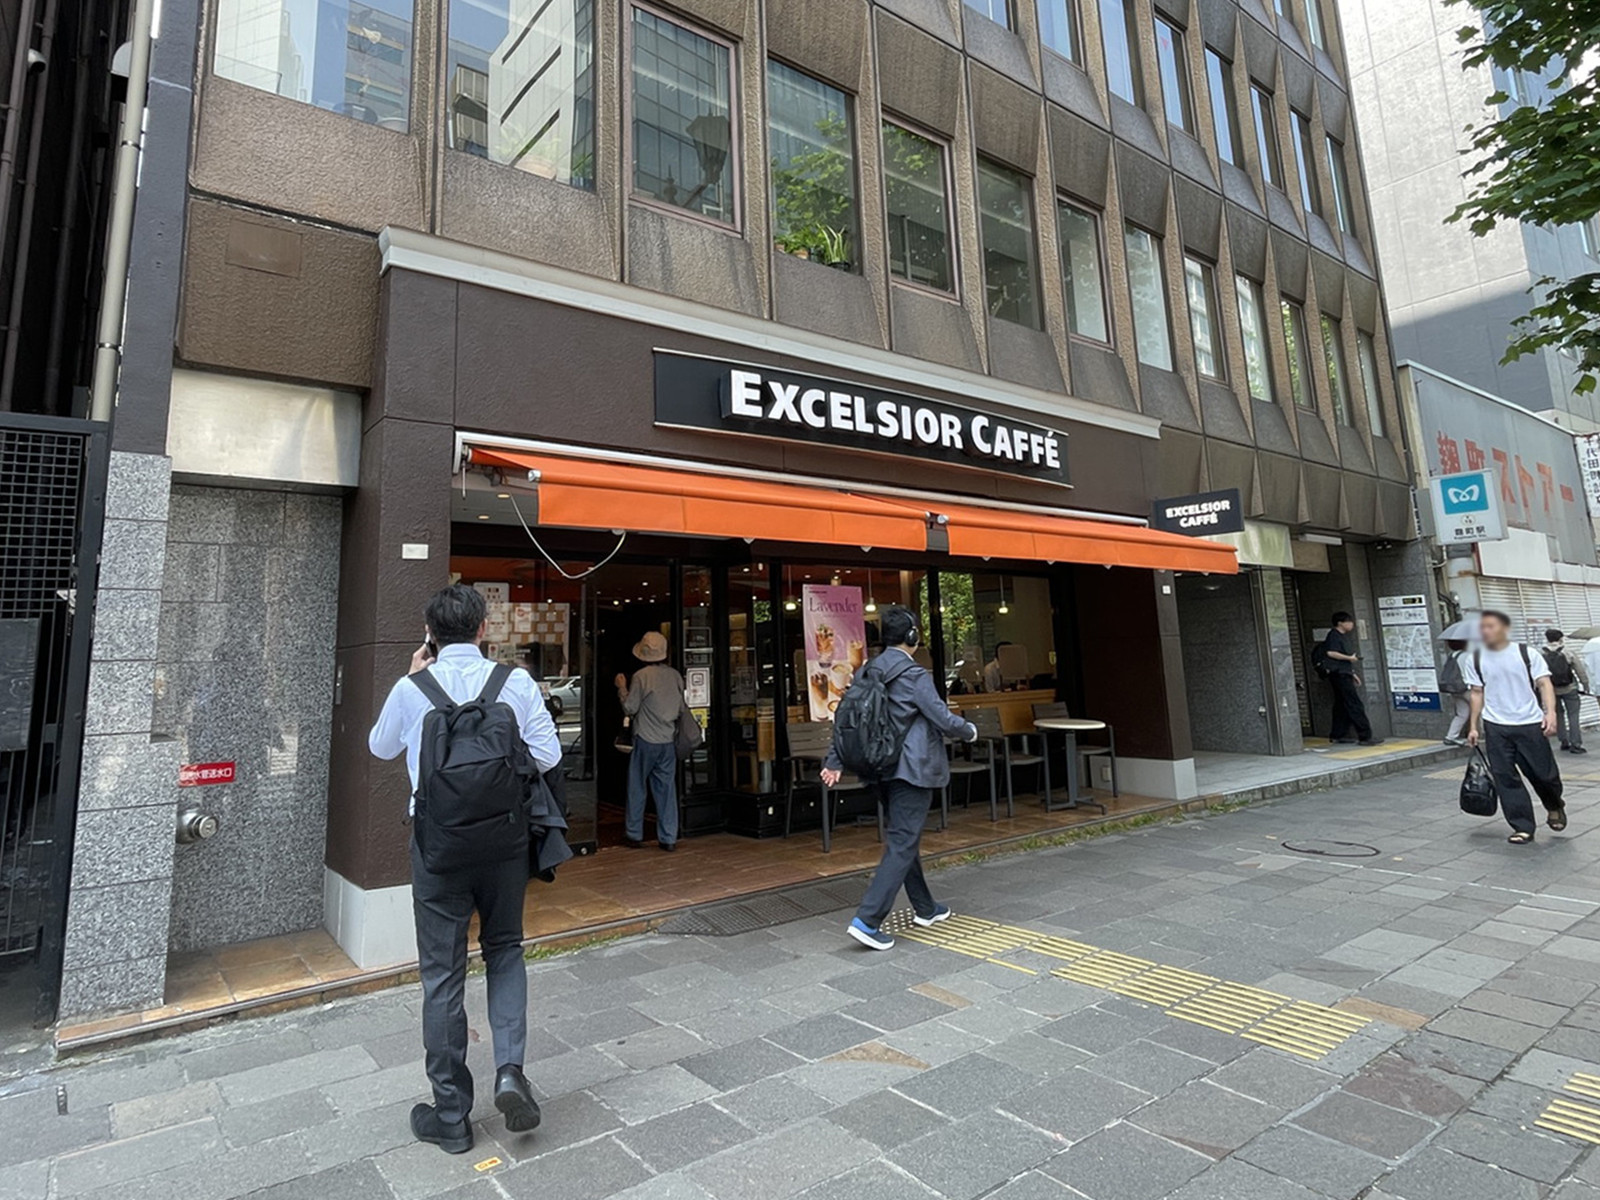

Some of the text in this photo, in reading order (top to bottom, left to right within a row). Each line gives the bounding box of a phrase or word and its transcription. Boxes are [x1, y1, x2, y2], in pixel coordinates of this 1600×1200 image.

[731, 369, 1061, 469] EXCELSIOR CAFFÉ
[1165, 499, 1231, 519] EXCELSIOR
[1179, 510, 1218, 528] CAFFÉ
[809, 596, 858, 613] Lavender
